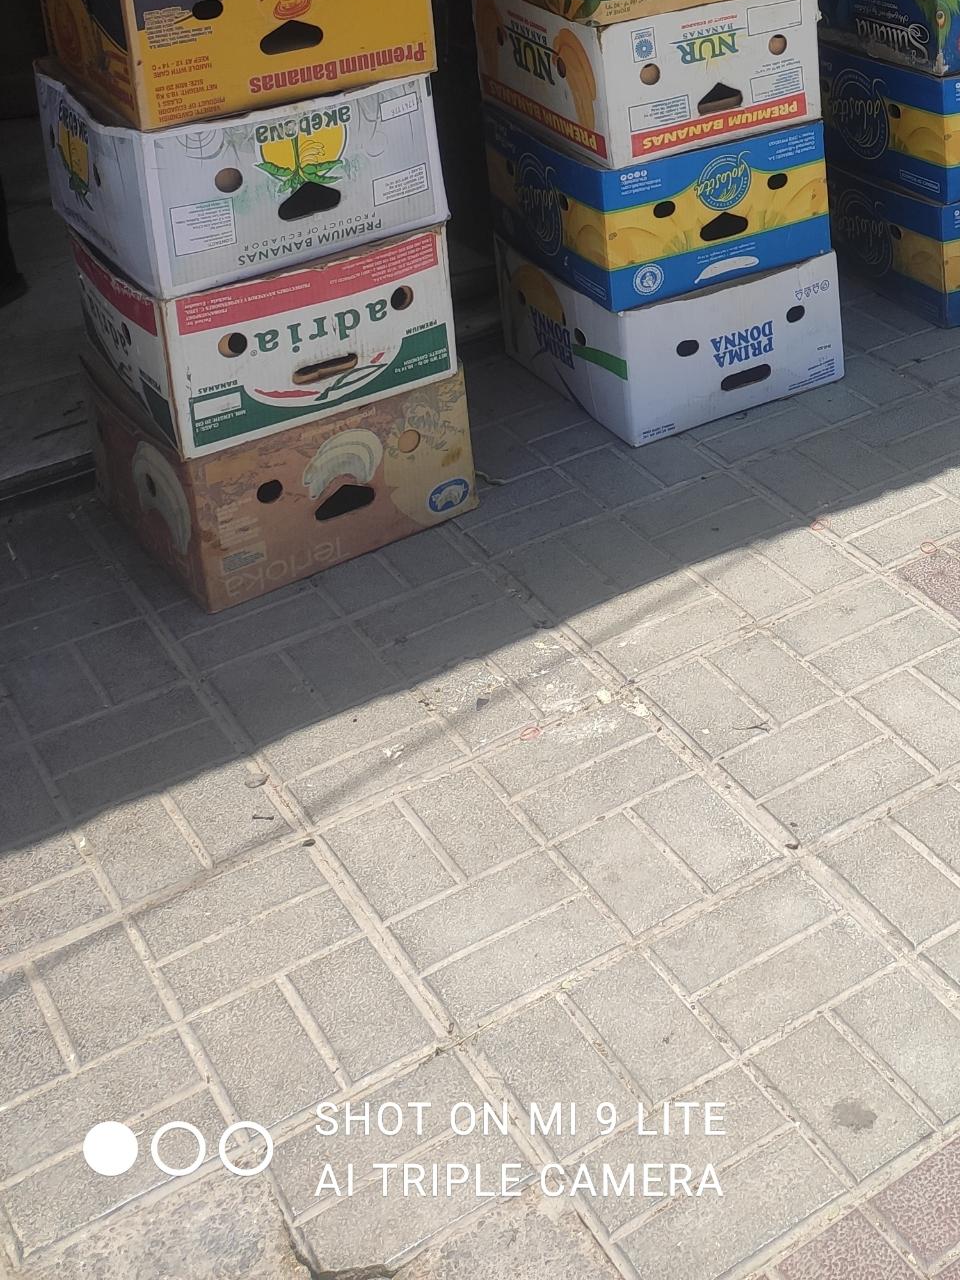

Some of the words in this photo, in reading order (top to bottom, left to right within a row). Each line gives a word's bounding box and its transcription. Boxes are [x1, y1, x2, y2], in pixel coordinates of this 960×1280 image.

[682, 23, 733, 38] BANANAS
[340, 42, 424, 77] Premium
[509, 34, 555, 85] NUR
[676, 32, 738, 65] NUR
[188, 63, 212, 72] HANDLE
[249, 62, 338, 94] Bananas
[159, 104, 186, 115] ECUADOR
[488, 80, 541, 118] BANANAS
[728, 101, 797, 126] PREMIUM
[543, 107, 597, 149] PREMIUM
[642, 119, 724, 149] BANANAS
[317, 218, 382, 244] PREMIUM
[322, 212, 375, 234] PRODUCT
[238, 237, 312, 266] BANANAS
[243, 230, 301, 252] ECUADOR
[254, 298, 387, 356] adria
[406, 320, 437, 335] PREMIUM
[711, 320, 773, 349] DONNA
[534, 332, 574, 369] PRIMA
[713, 337, 774, 368] PRIMA
[198, 380, 237, 394] BANANAS
